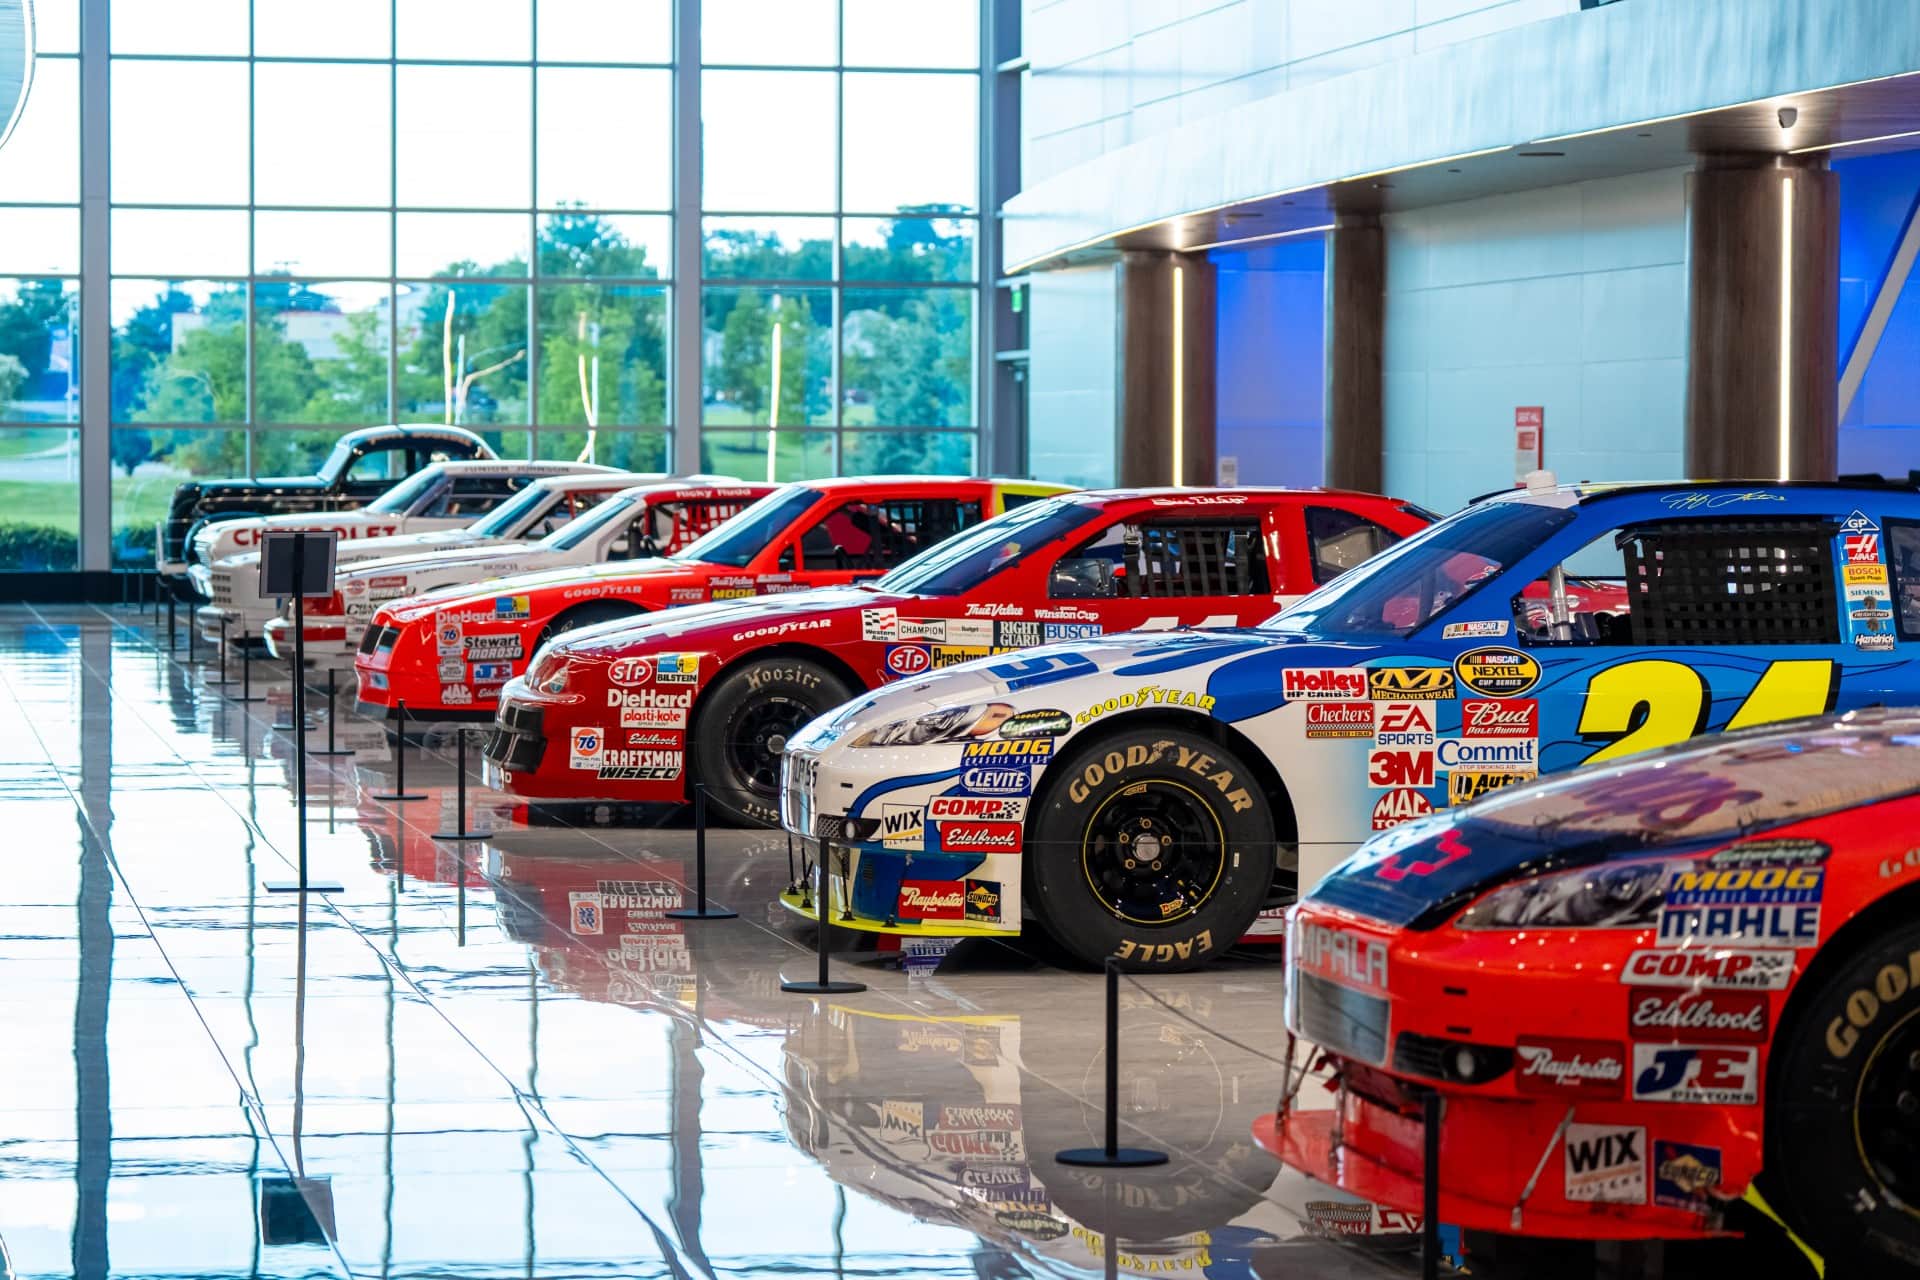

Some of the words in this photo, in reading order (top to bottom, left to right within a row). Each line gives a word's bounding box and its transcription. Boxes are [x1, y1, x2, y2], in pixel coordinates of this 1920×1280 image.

[1847, 518, 1868, 529] GP
[233, 525, 398, 546] CHOLET
[1848, 567, 1882, 576] BOSCH
[563, 584, 643, 599] GOODYEAR
[711, 588, 757, 599] MOOG
[1850, 588, 1885, 597] SIEMENS
[435, 608, 496, 624] DieHard
[1034, 608, 1076, 619] Winston
[1076, 609, 1099, 622] Cup
[442, 629, 457, 640] 76
[732, 618, 832, 641] GOODYEAR
[900, 625, 944, 635] CHAMPION
[1000, 621, 1040, 634] RIGHT
[1046, 624, 1100, 639] BUSCH
[464, 634, 520, 648] Stewart
[1000, 634, 1040, 647] GUARD
[1855, 633, 1894, 645] Hendrick
[893, 649, 924, 669] STP
[1486, 655, 1519, 664] NASCAR
[613, 660, 646, 681] STP
[657, 674, 697, 682] BILSTEIN
[1472, 666, 1524, 676] NEXTEL
[1285, 670, 1366, 698] Holley
[607, 688, 692, 708] DieHard
[1371, 689, 1425, 700] MECHANIX
[1425, 688, 1455, 699] WEAR
[1075, 685, 1216, 725] GOODYEAR
[1308, 704, 1371, 722] Checkers
[1379, 704, 1433, 732] EA
[1464, 702, 1536, 726] Bud
[579, 735, 597, 751] 76
[628, 732, 678, 746] Edelbrock
[964, 738, 1052, 757] MOOG
[1378, 733, 1434, 745] SPORTS
[603, 749, 683, 768] CRAFTSMAN
[1437, 740, 1534, 766] Commit
[599, 767, 681, 779] WISECO
[1369, 751, 1434, 785] 3M
[964, 767, 1026, 788] CLEVITE
[1068, 740, 1254, 814] GOODYEAR
[931, 800, 1003, 816] COMP
[1374, 789, 1432, 818] MAC
[884, 809, 923, 834] WIX
[978, 812, 1014, 820] CAMS
[946, 828, 1016, 846] Edelbrock
[1673, 869, 1821, 891] MOOG
[968, 892, 997, 904] SUNOCO
[1659, 907, 1818, 938] MAHLE
[1113, 929, 1213, 963] EAGLE
[1632, 953, 1754, 978] COMP
[1632, 998, 1763, 1032] Edelbrock
[1636, 1050, 1749, 1095] JE
[1670, 1090, 1755, 1102] PISTONS
[1567, 1131, 1639, 1174] WIX
